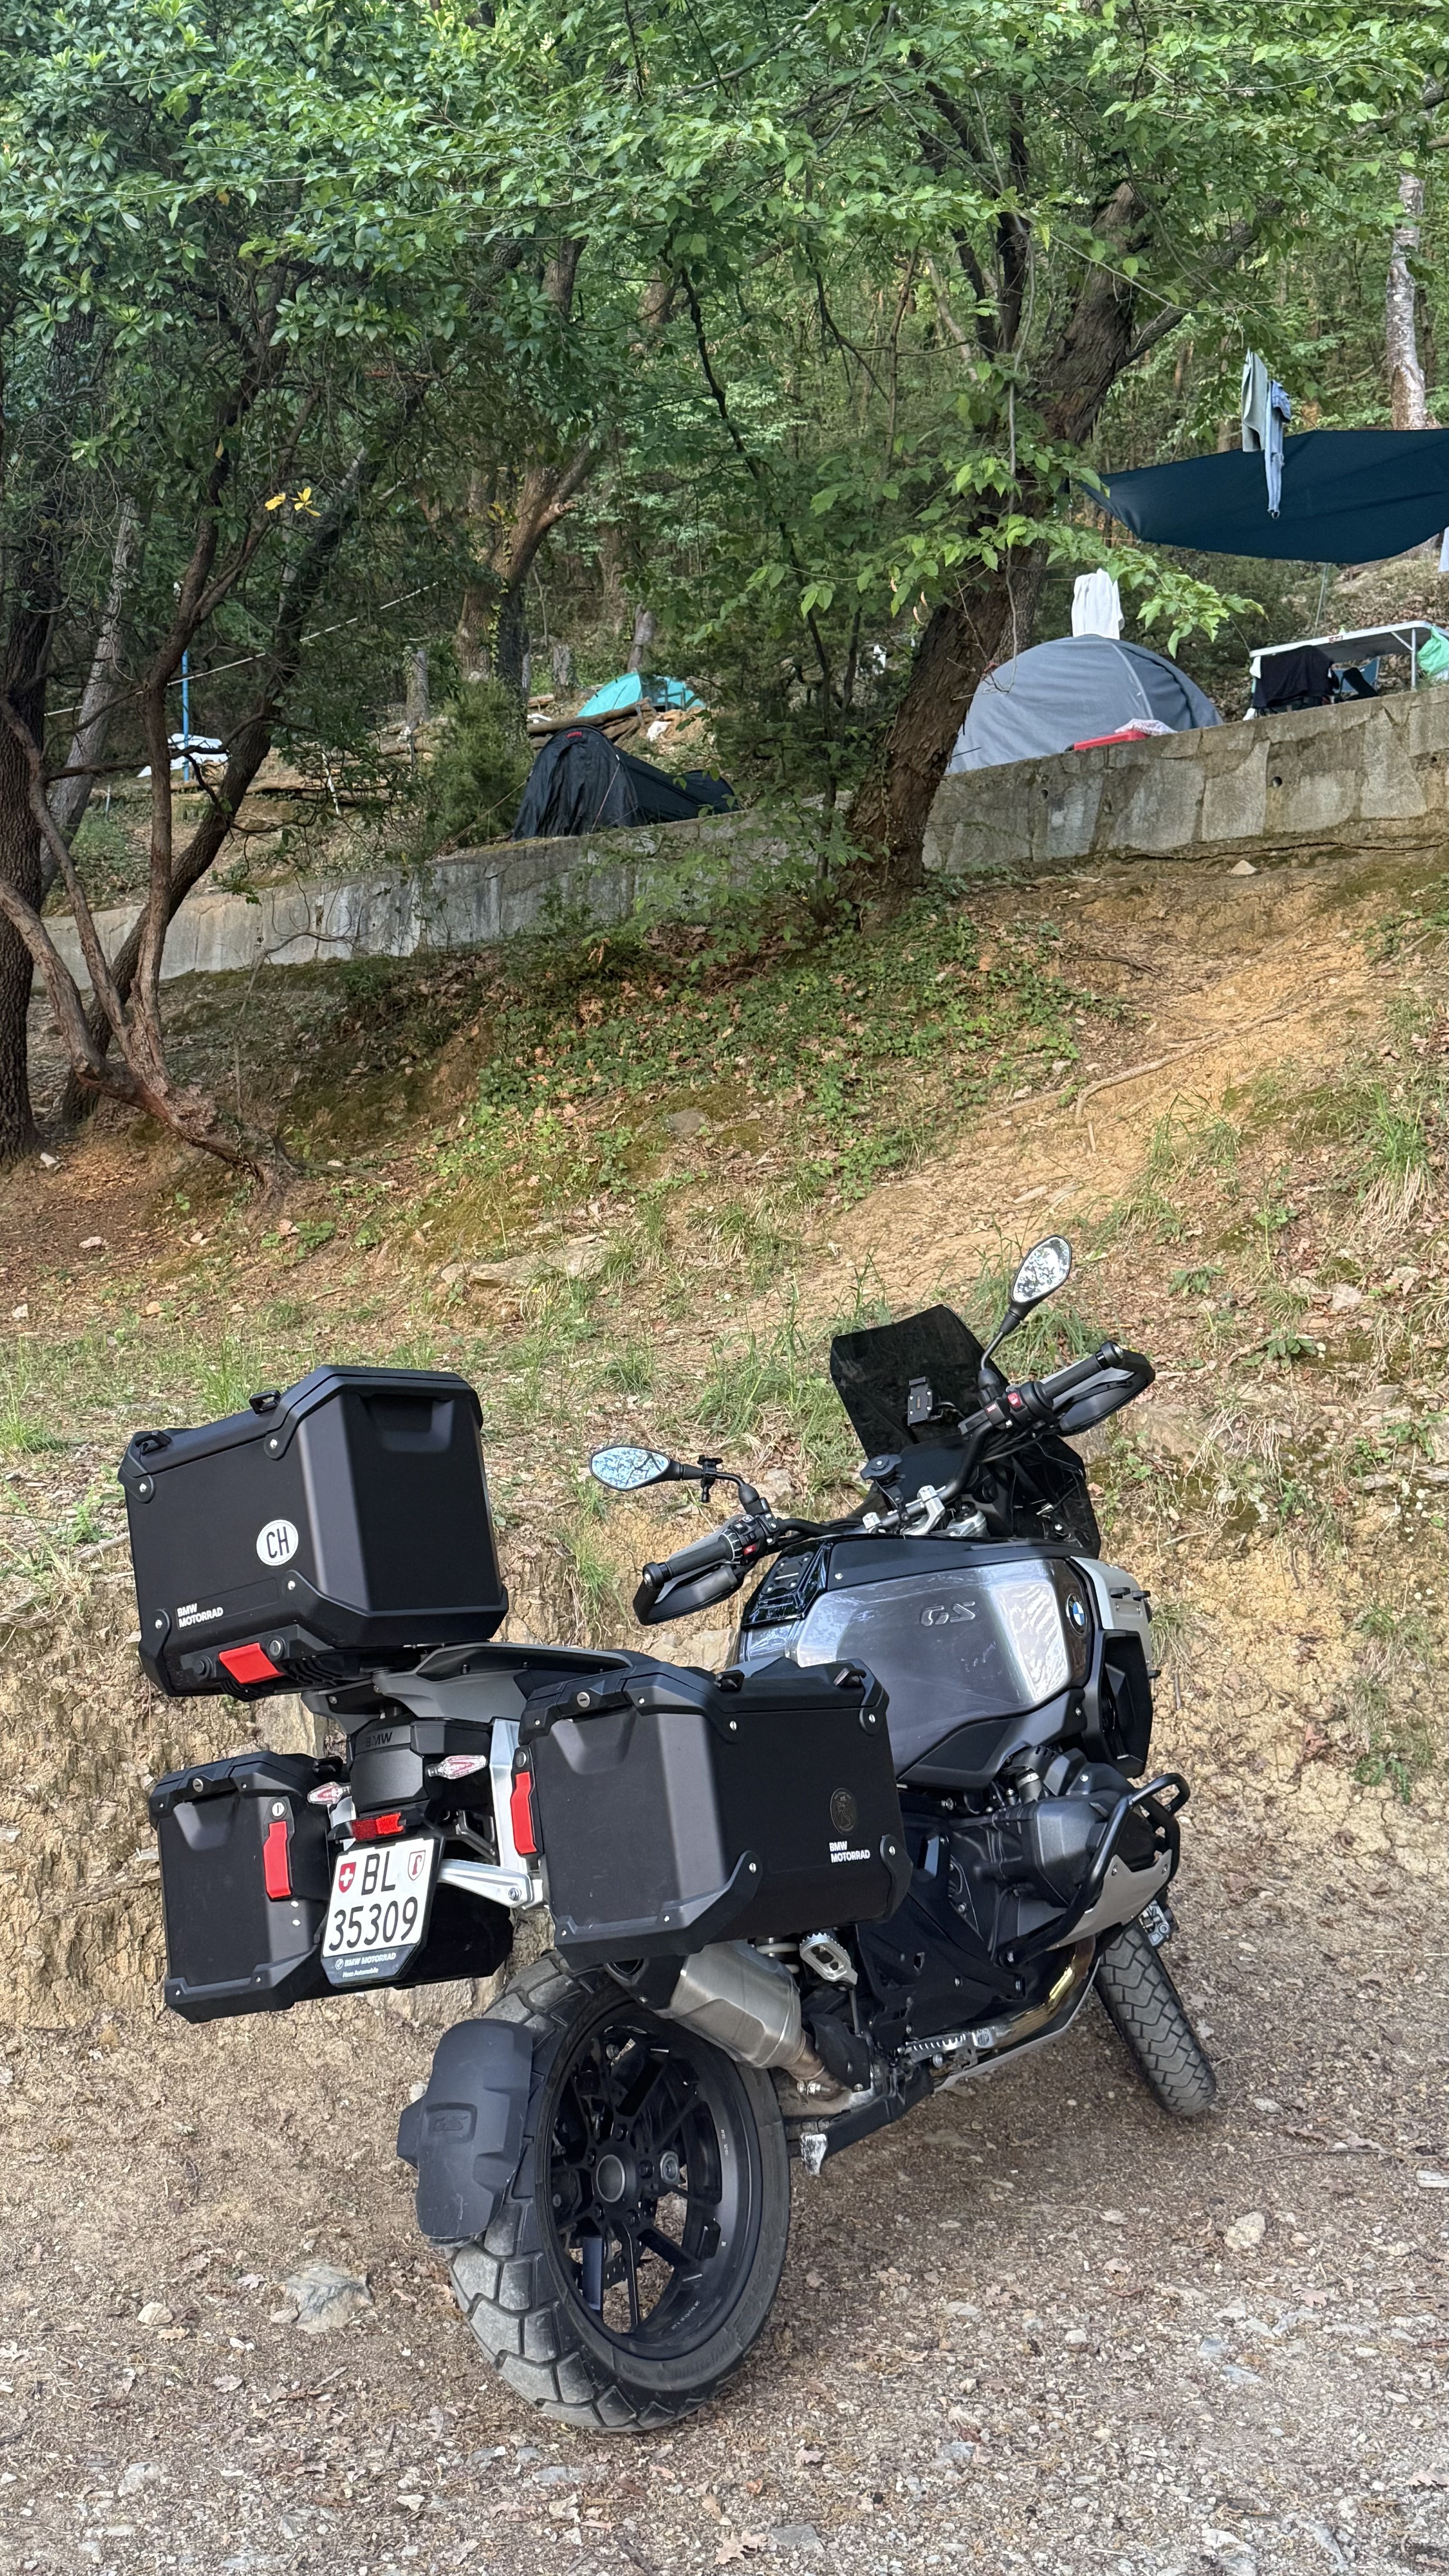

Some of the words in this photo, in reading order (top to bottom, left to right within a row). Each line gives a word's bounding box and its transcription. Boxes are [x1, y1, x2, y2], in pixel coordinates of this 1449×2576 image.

[267, 1526, 290, 1559] CH
[177, 1603, 198, 1618] BMW
[179, 1607, 224, 1628] MOTORRAD
[921, 1601, 975, 1626] GS
[365, 1732, 393, 1748] BMW
[829, 1841, 847, 1852] BMW
[830, 1849, 871, 1863] MOTORRAD
[361, 1851, 396, 1895] BL
[329, 1896, 418, 1951] 35309
[344, 1957, 361, 1967] BMW
[361, 1952, 397, 1965] MOTORRAD
[354, 1967, 379, 1976] Automobile
